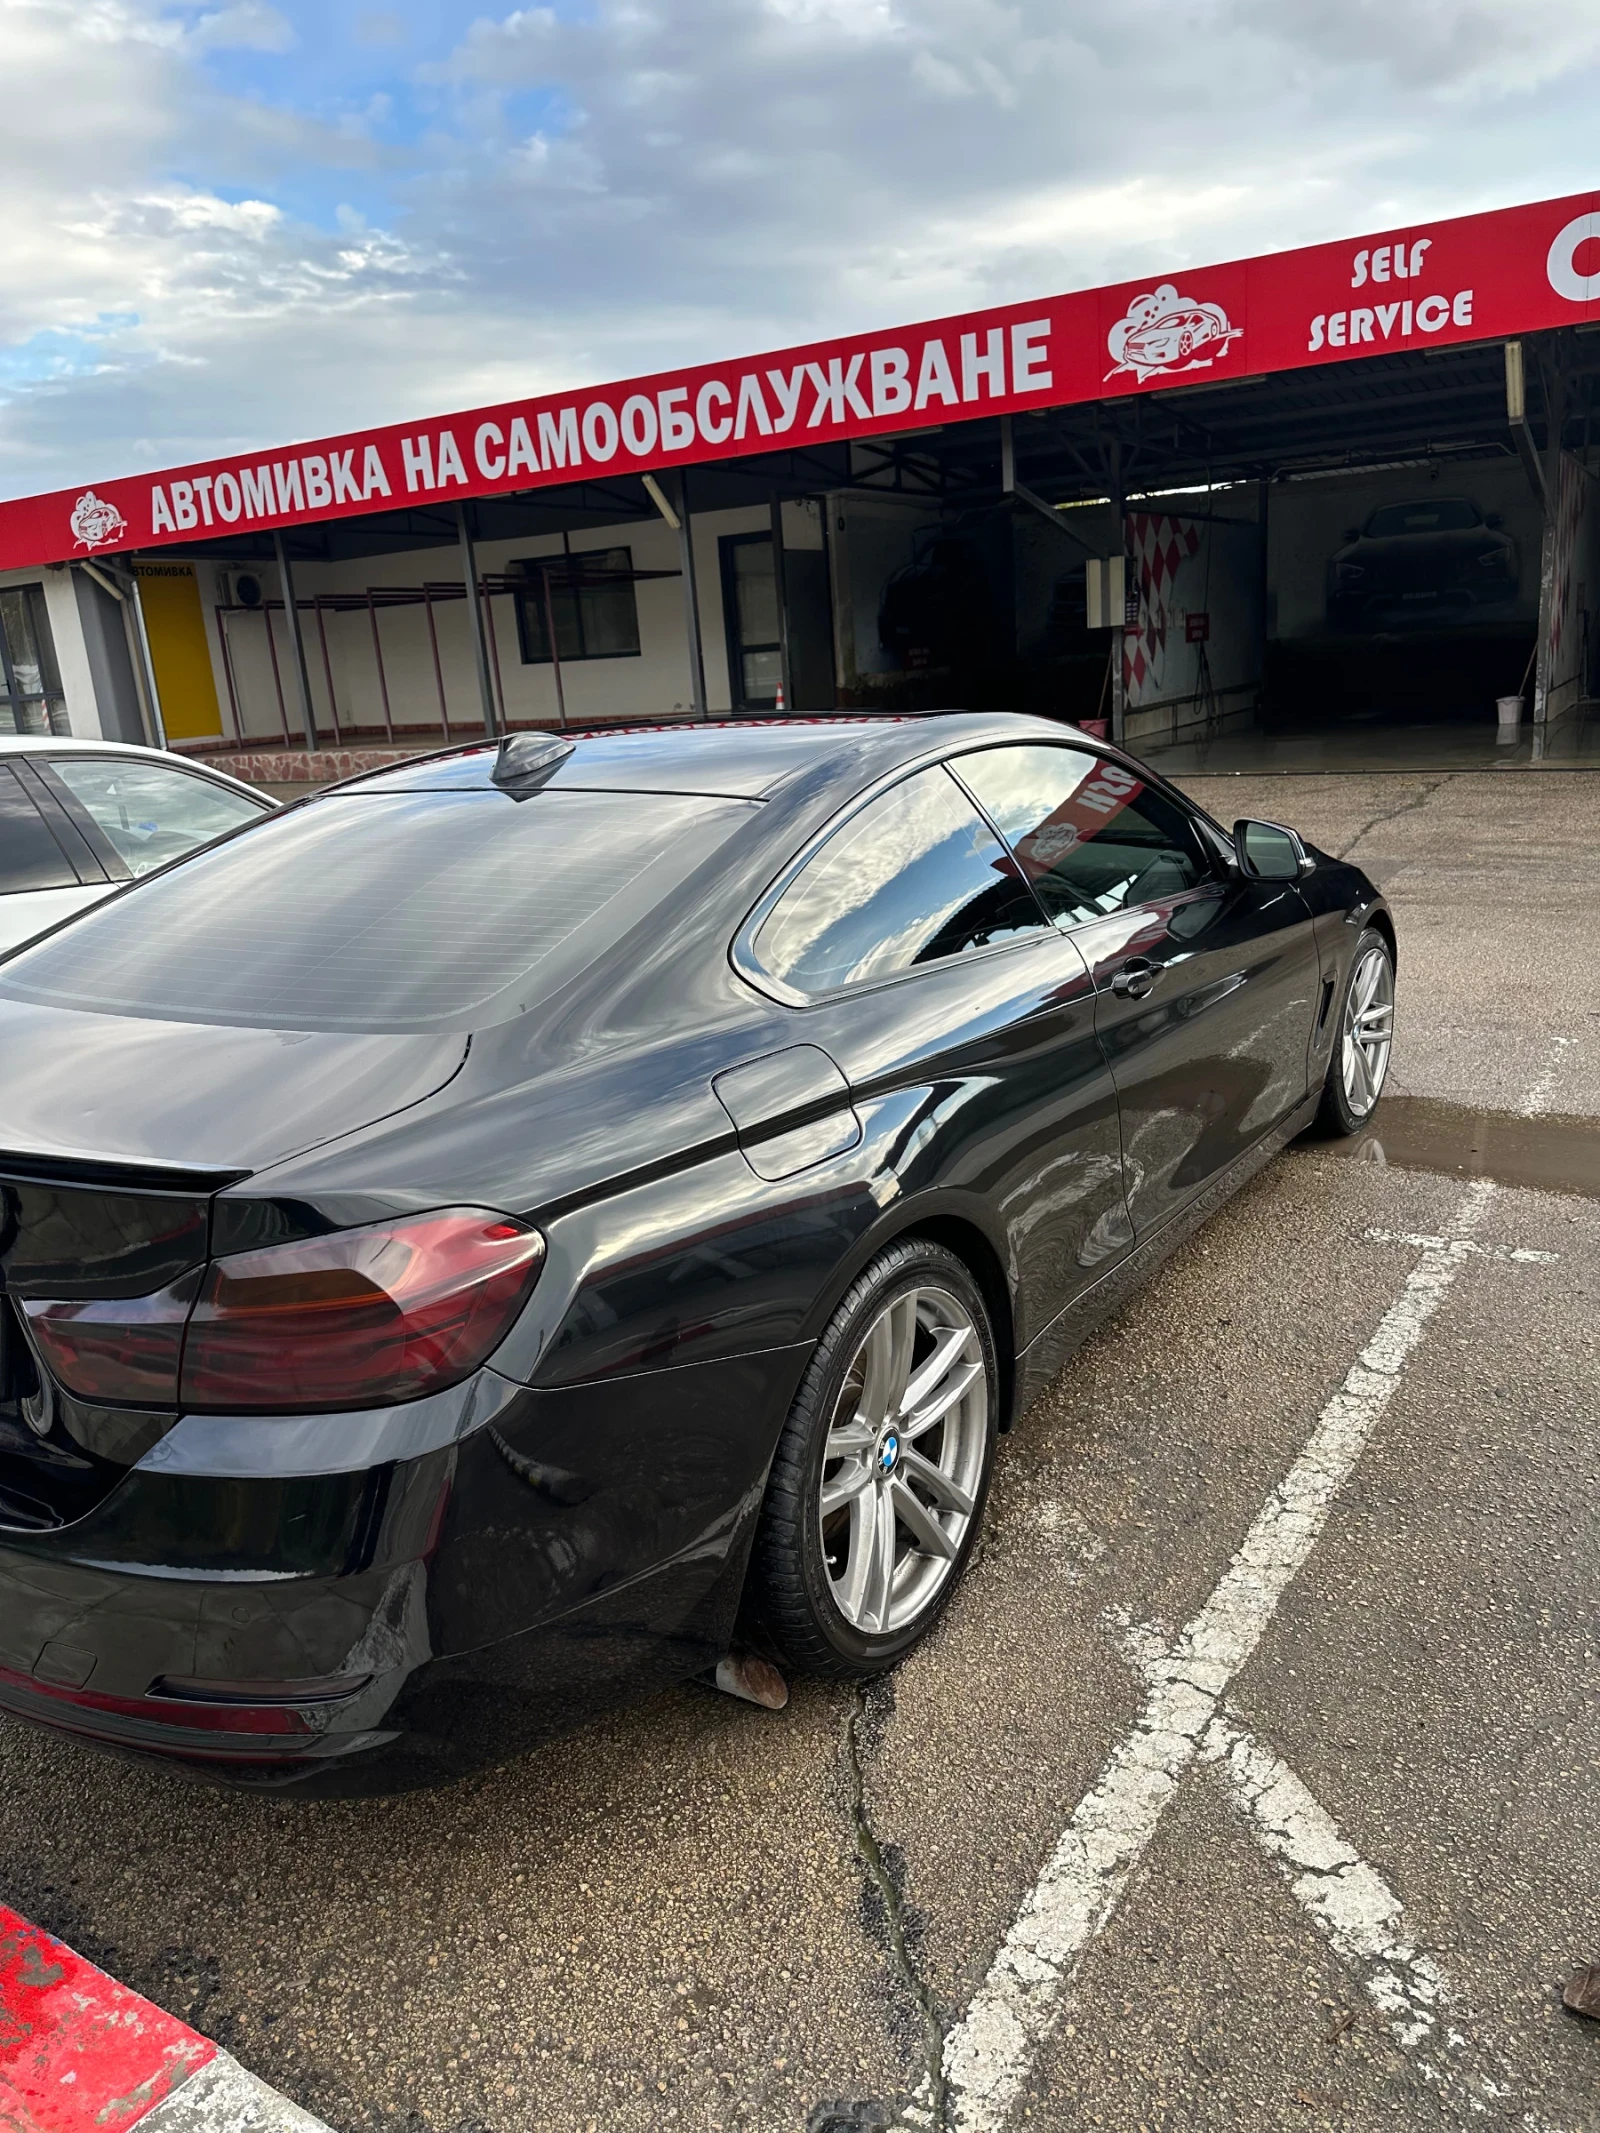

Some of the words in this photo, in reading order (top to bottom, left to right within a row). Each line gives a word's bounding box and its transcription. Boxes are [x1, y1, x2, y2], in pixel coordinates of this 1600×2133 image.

[1351, 238, 1432, 288] SELF
[1308, 290, 1473, 351] SERVICE
[152, 445, 392, 534] АВТОМИВКА
[401, 430, 469, 494] НА
[474, 318, 1053, 480] САМООБСЛУЖВАНЕ
[132, 566, 193, 577] ВТОМИВКА
